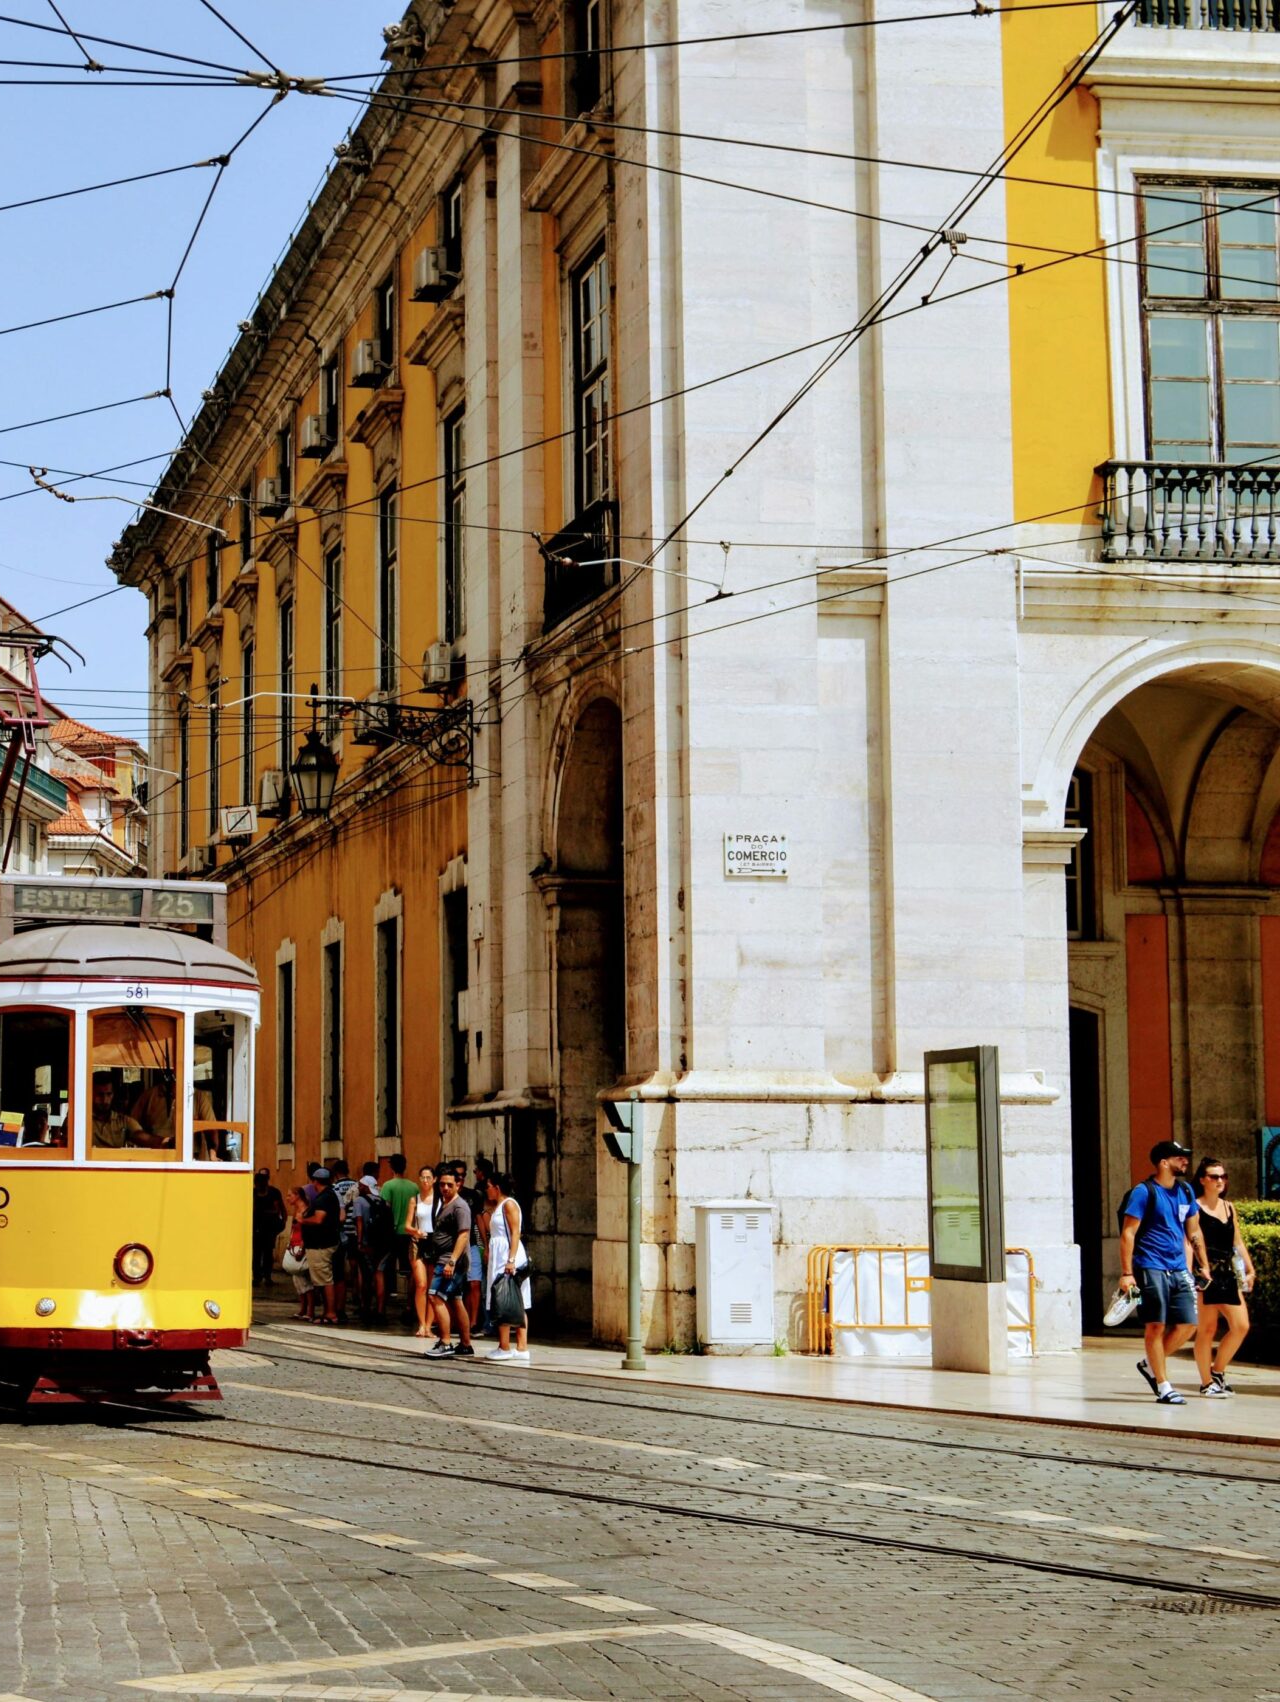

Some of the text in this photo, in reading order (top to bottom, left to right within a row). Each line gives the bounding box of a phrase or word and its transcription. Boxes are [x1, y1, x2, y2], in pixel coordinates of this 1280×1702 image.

[736, 834, 778, 846] PRAÇA
[727, 850, 787, 861] COMERCIO
[21, 888, 132, 909] ESTRELA
[157, 892, 194, 917] 25
[126, 986, 149, 999] 581
